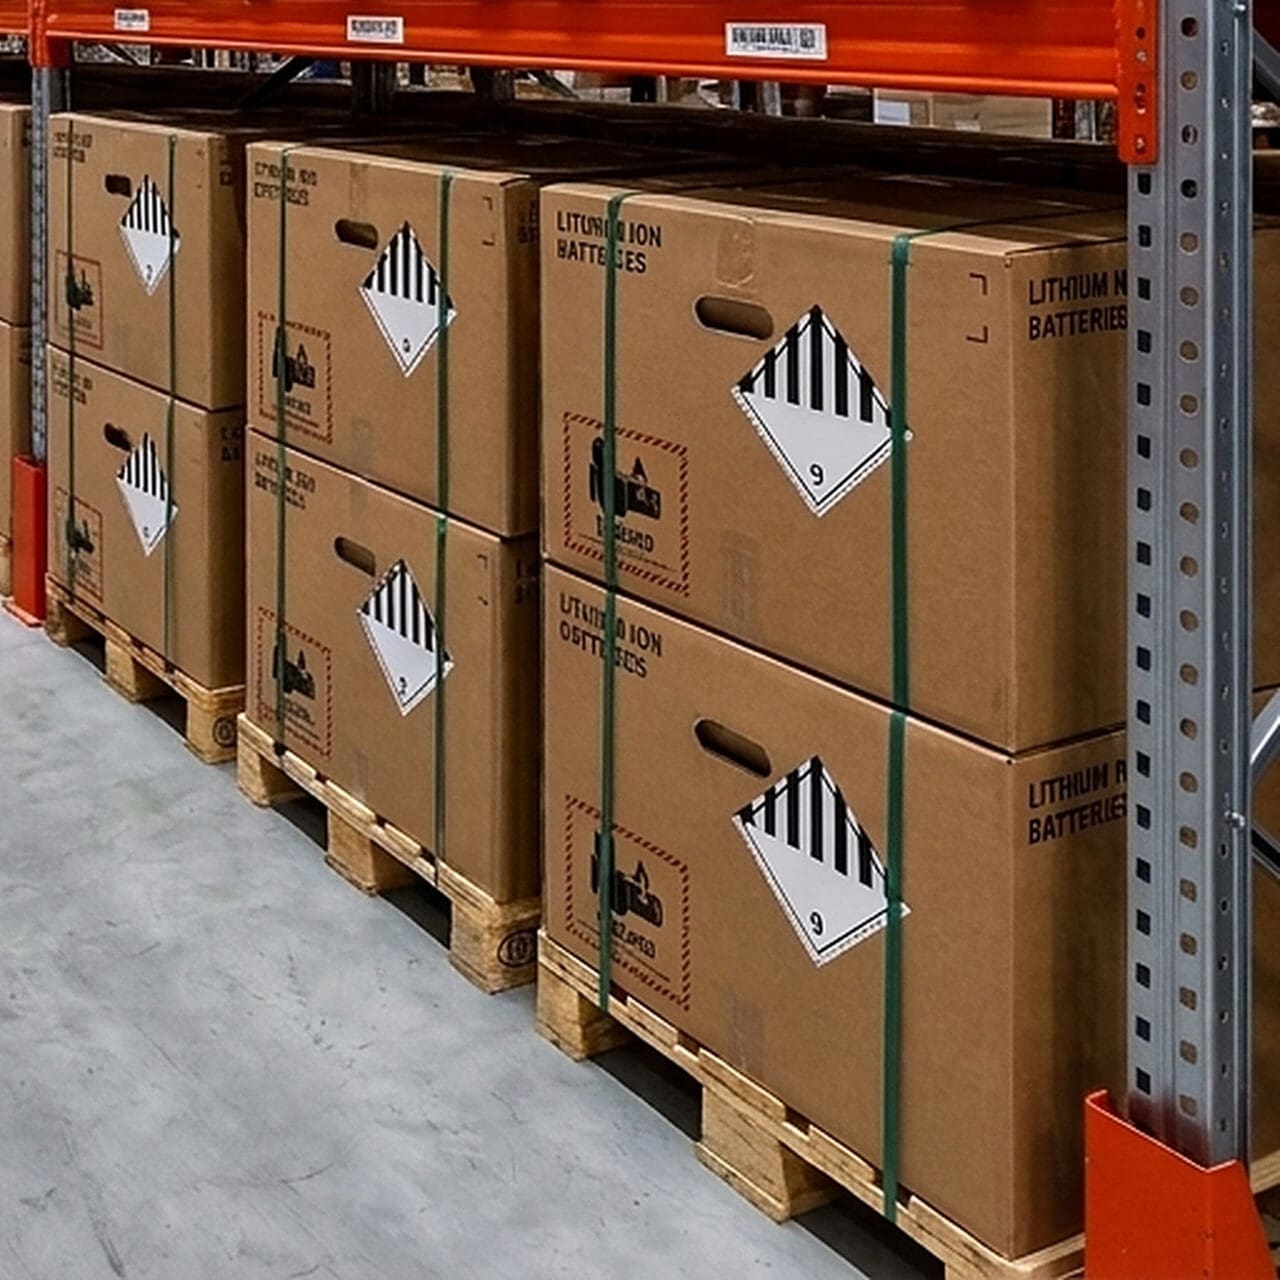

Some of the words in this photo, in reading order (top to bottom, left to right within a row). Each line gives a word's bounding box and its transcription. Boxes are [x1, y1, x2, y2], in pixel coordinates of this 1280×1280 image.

[629, 221, 662, 248] ION
[1028, 271, 1108, 305] LITHIUM
[810, 463, 824, 486] 9
[1028, 762, 1108, 809] LITHIUM
[810, 911, 823, 936] 9
